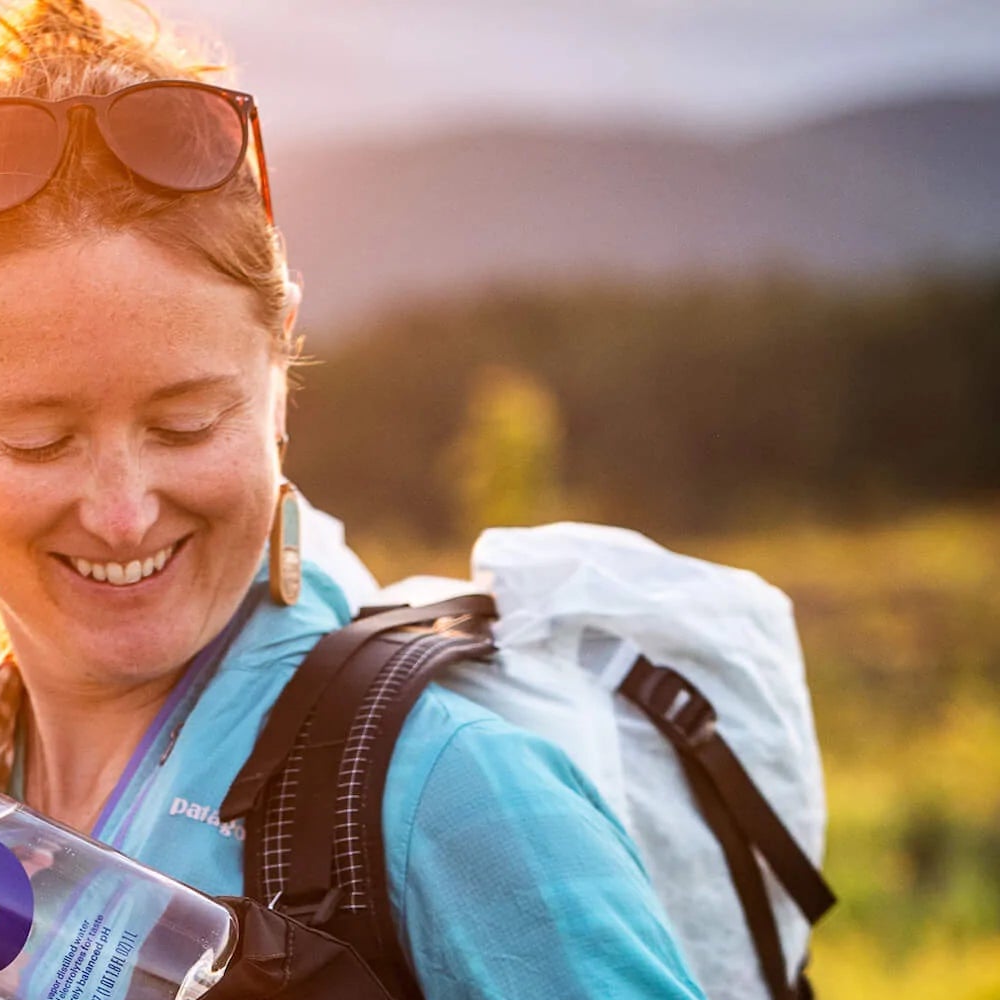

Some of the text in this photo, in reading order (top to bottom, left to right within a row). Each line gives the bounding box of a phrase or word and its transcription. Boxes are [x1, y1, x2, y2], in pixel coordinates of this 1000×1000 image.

[48, 920, 90, 1000] vapor distilled water
[59, 951, 86, 999] electrolytes
[80, 938, 92, 951] for
[89, 914, 104, 936] taste
[76, 942, 103, 986] balanced
[100, 926, 112, 944] pH
[105, 964, 121, 978] 1.8
[115, 941, 134, 957] OZ)
